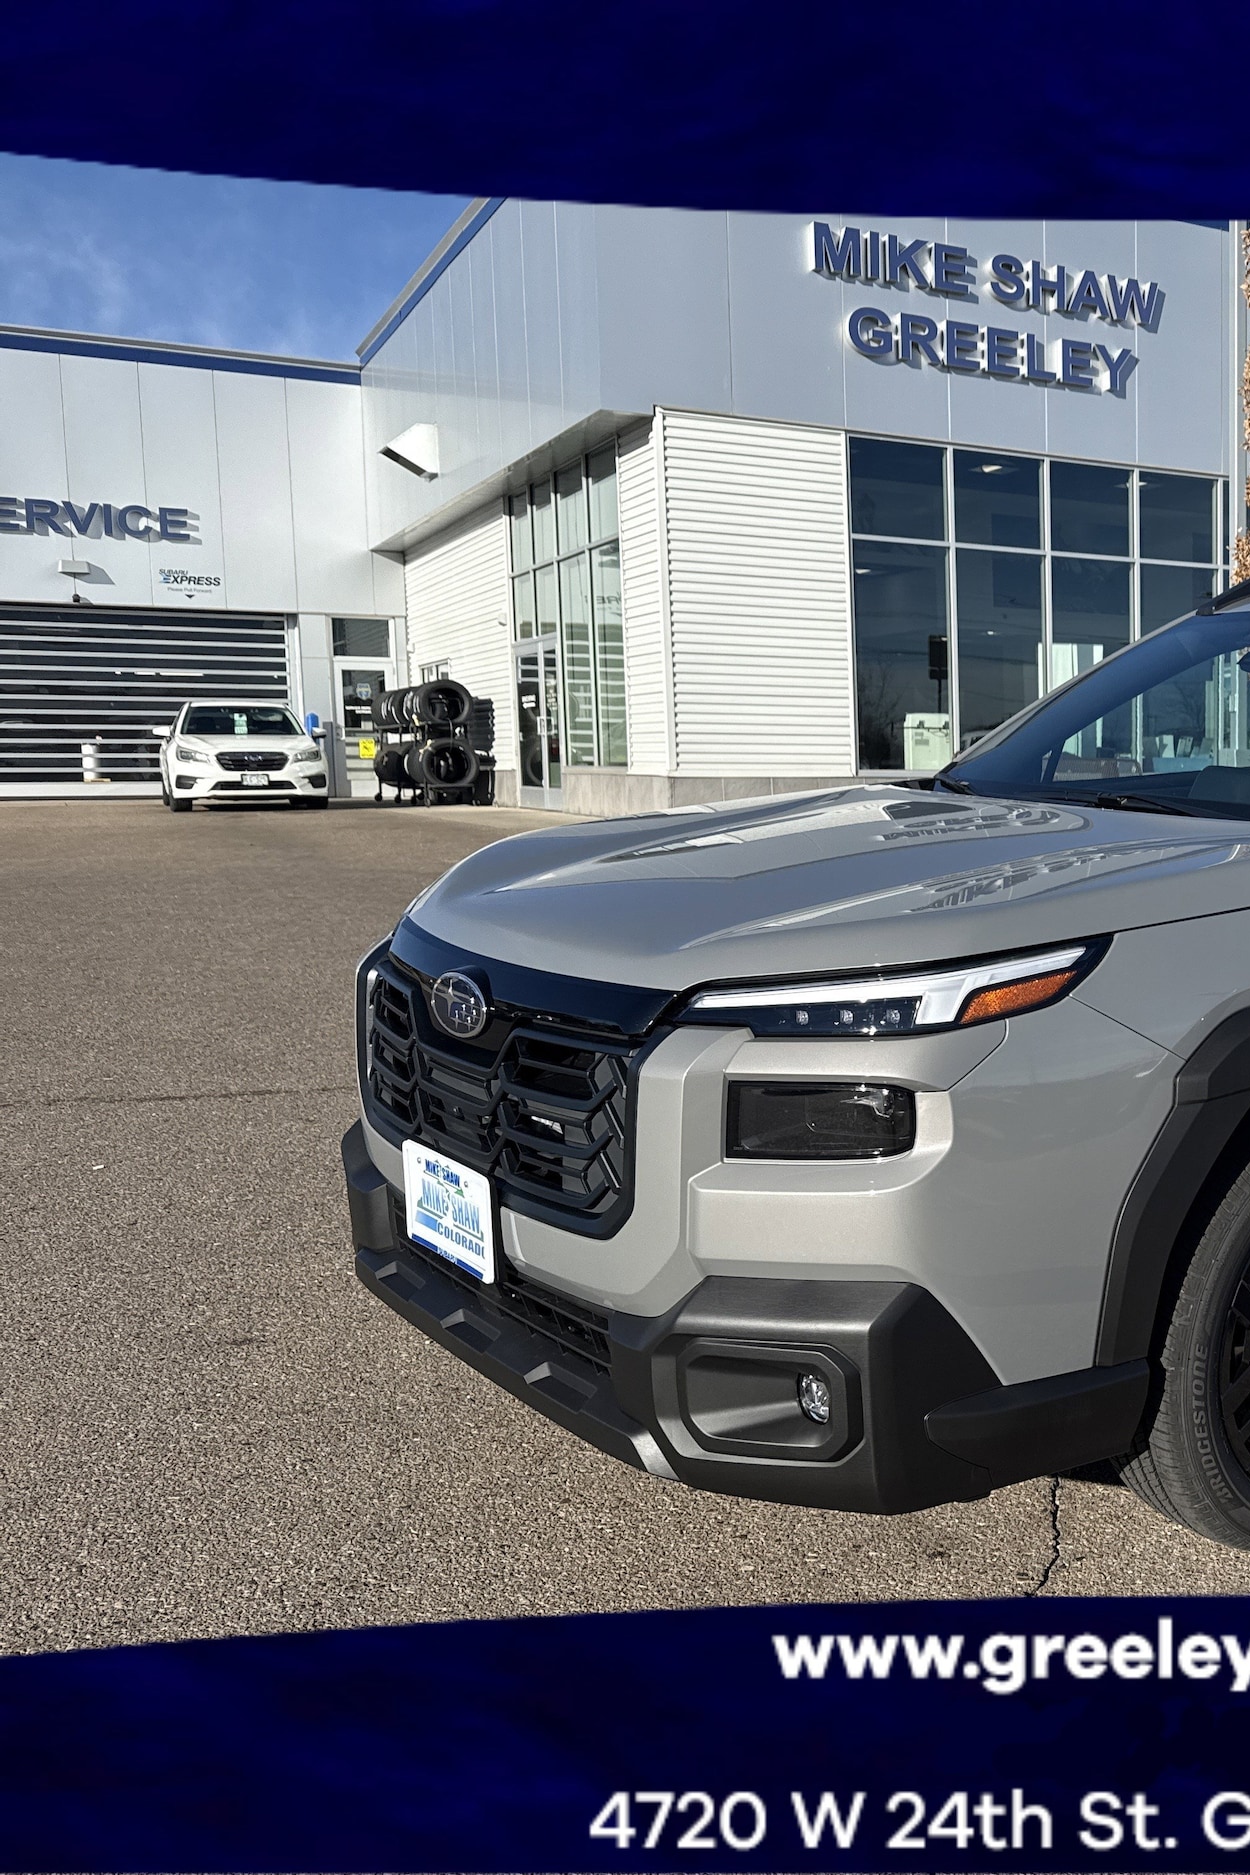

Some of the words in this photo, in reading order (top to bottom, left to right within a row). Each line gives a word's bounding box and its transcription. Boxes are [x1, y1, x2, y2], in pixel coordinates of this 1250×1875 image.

[813, 221, 971, 294] MIKE
[990, 254, 1159, 326] SHAW
[848, 306, 1133, 391] GREELEY
[0, 497, 191, 541] ERVICE
[160, 574, 221, 586] EXPRESS
[425, 1159, 440, 1177] MIKE
[421, 1178, 448, 1217] MIKE
[451, 1194, 480, 1234] SHAW
[1192, 1343, 1234, 1501] BRIDGESTONE
